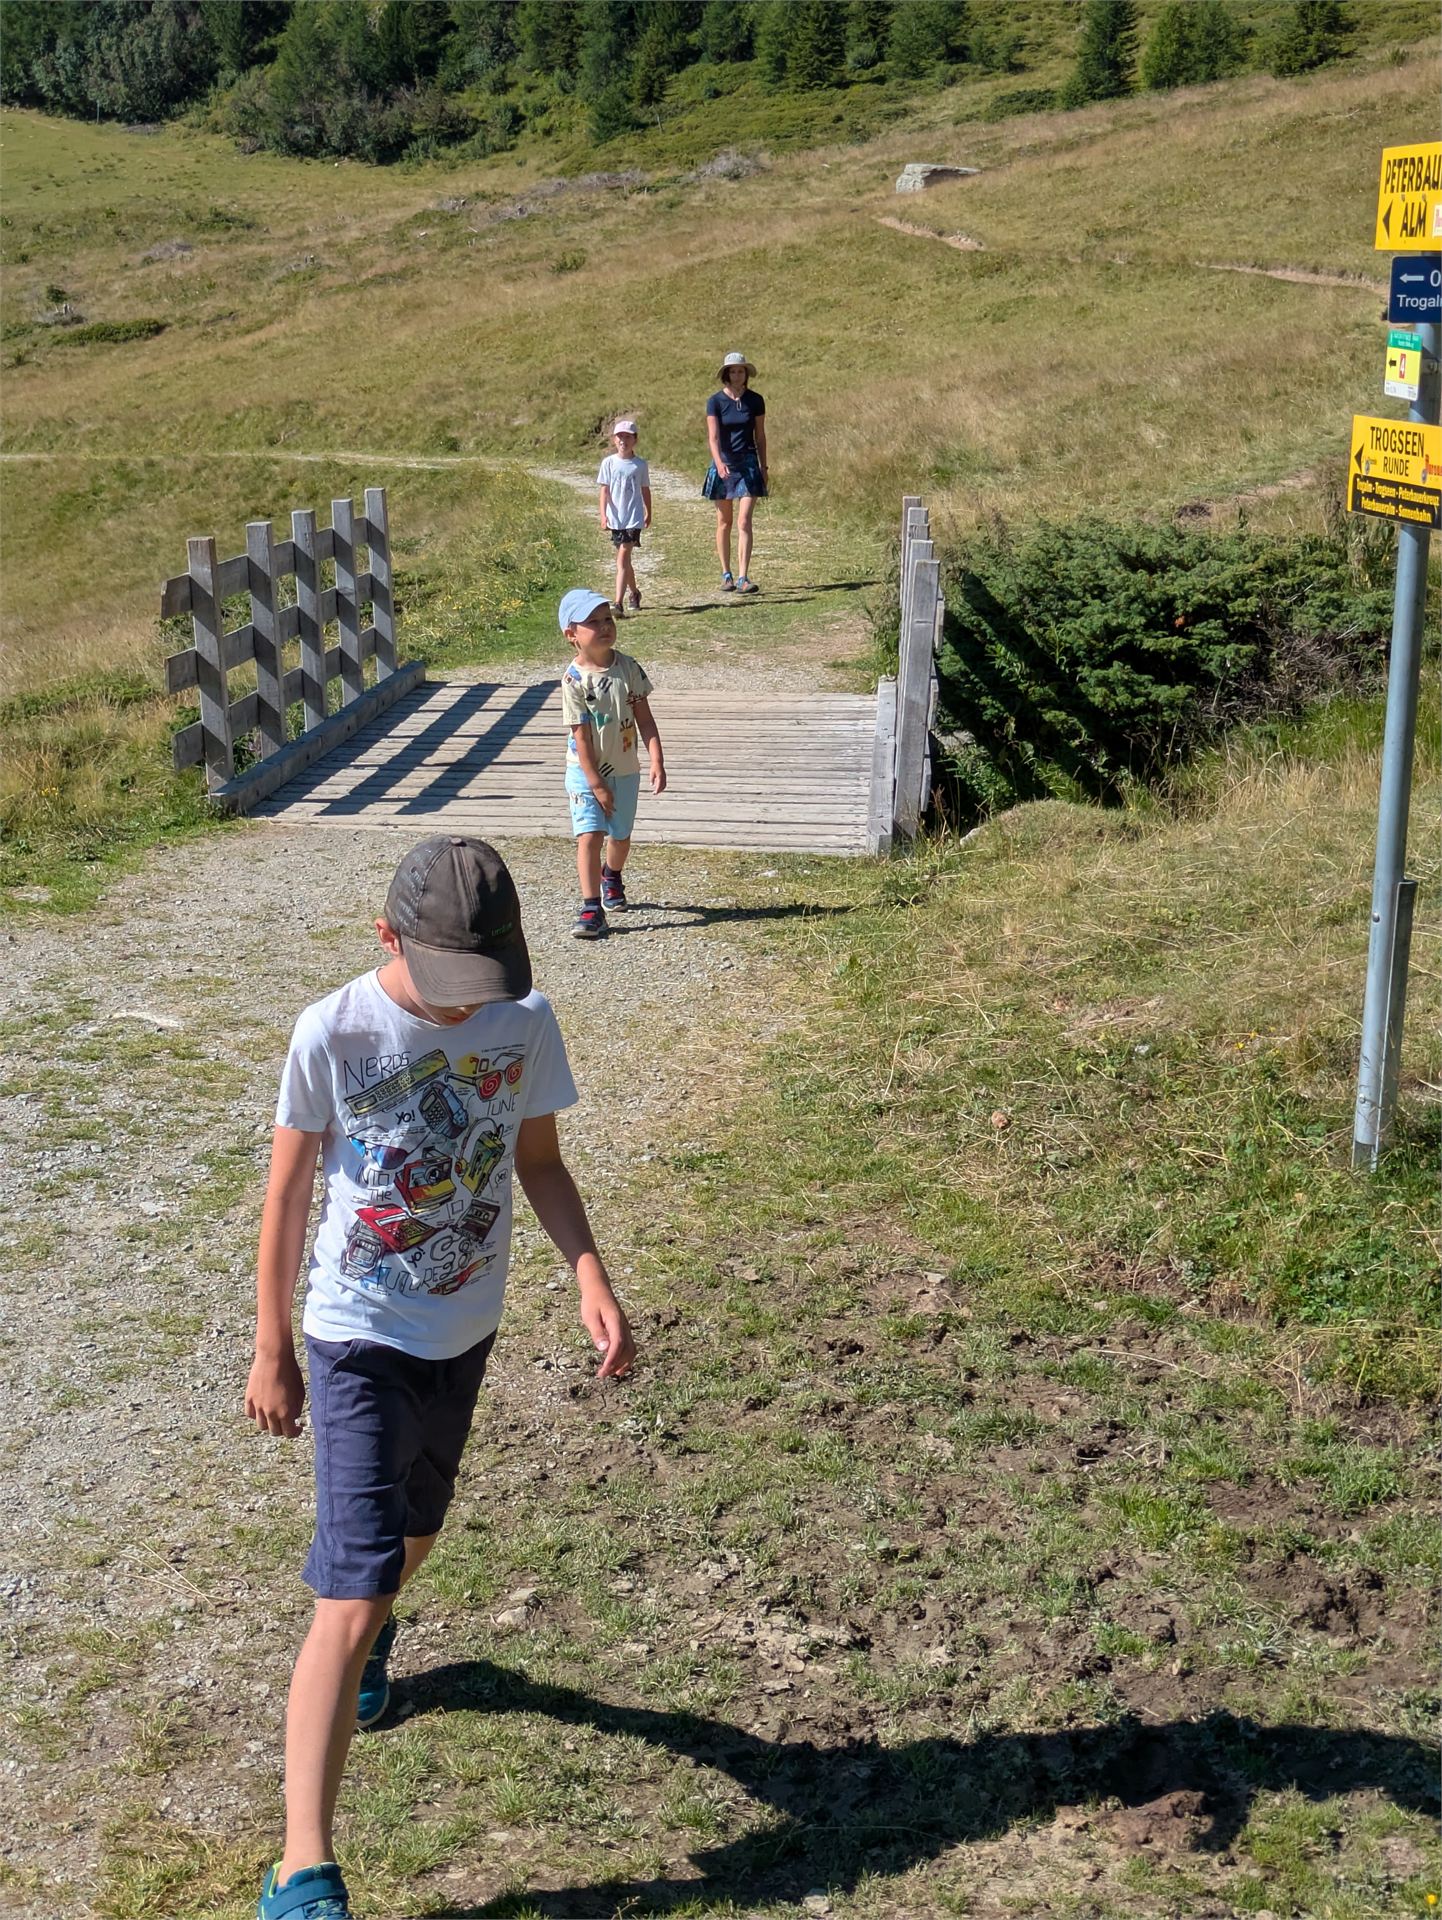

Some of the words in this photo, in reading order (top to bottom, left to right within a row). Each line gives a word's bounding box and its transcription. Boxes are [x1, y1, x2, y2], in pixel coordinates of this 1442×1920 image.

[1384, 154, 1442, 194] PETERBAU
[1399, 201, 1428, 237] ALM
[1370, 426, 1425, 458] TROGSEEN
[1383, 456, 1410, 477] RUNDE
